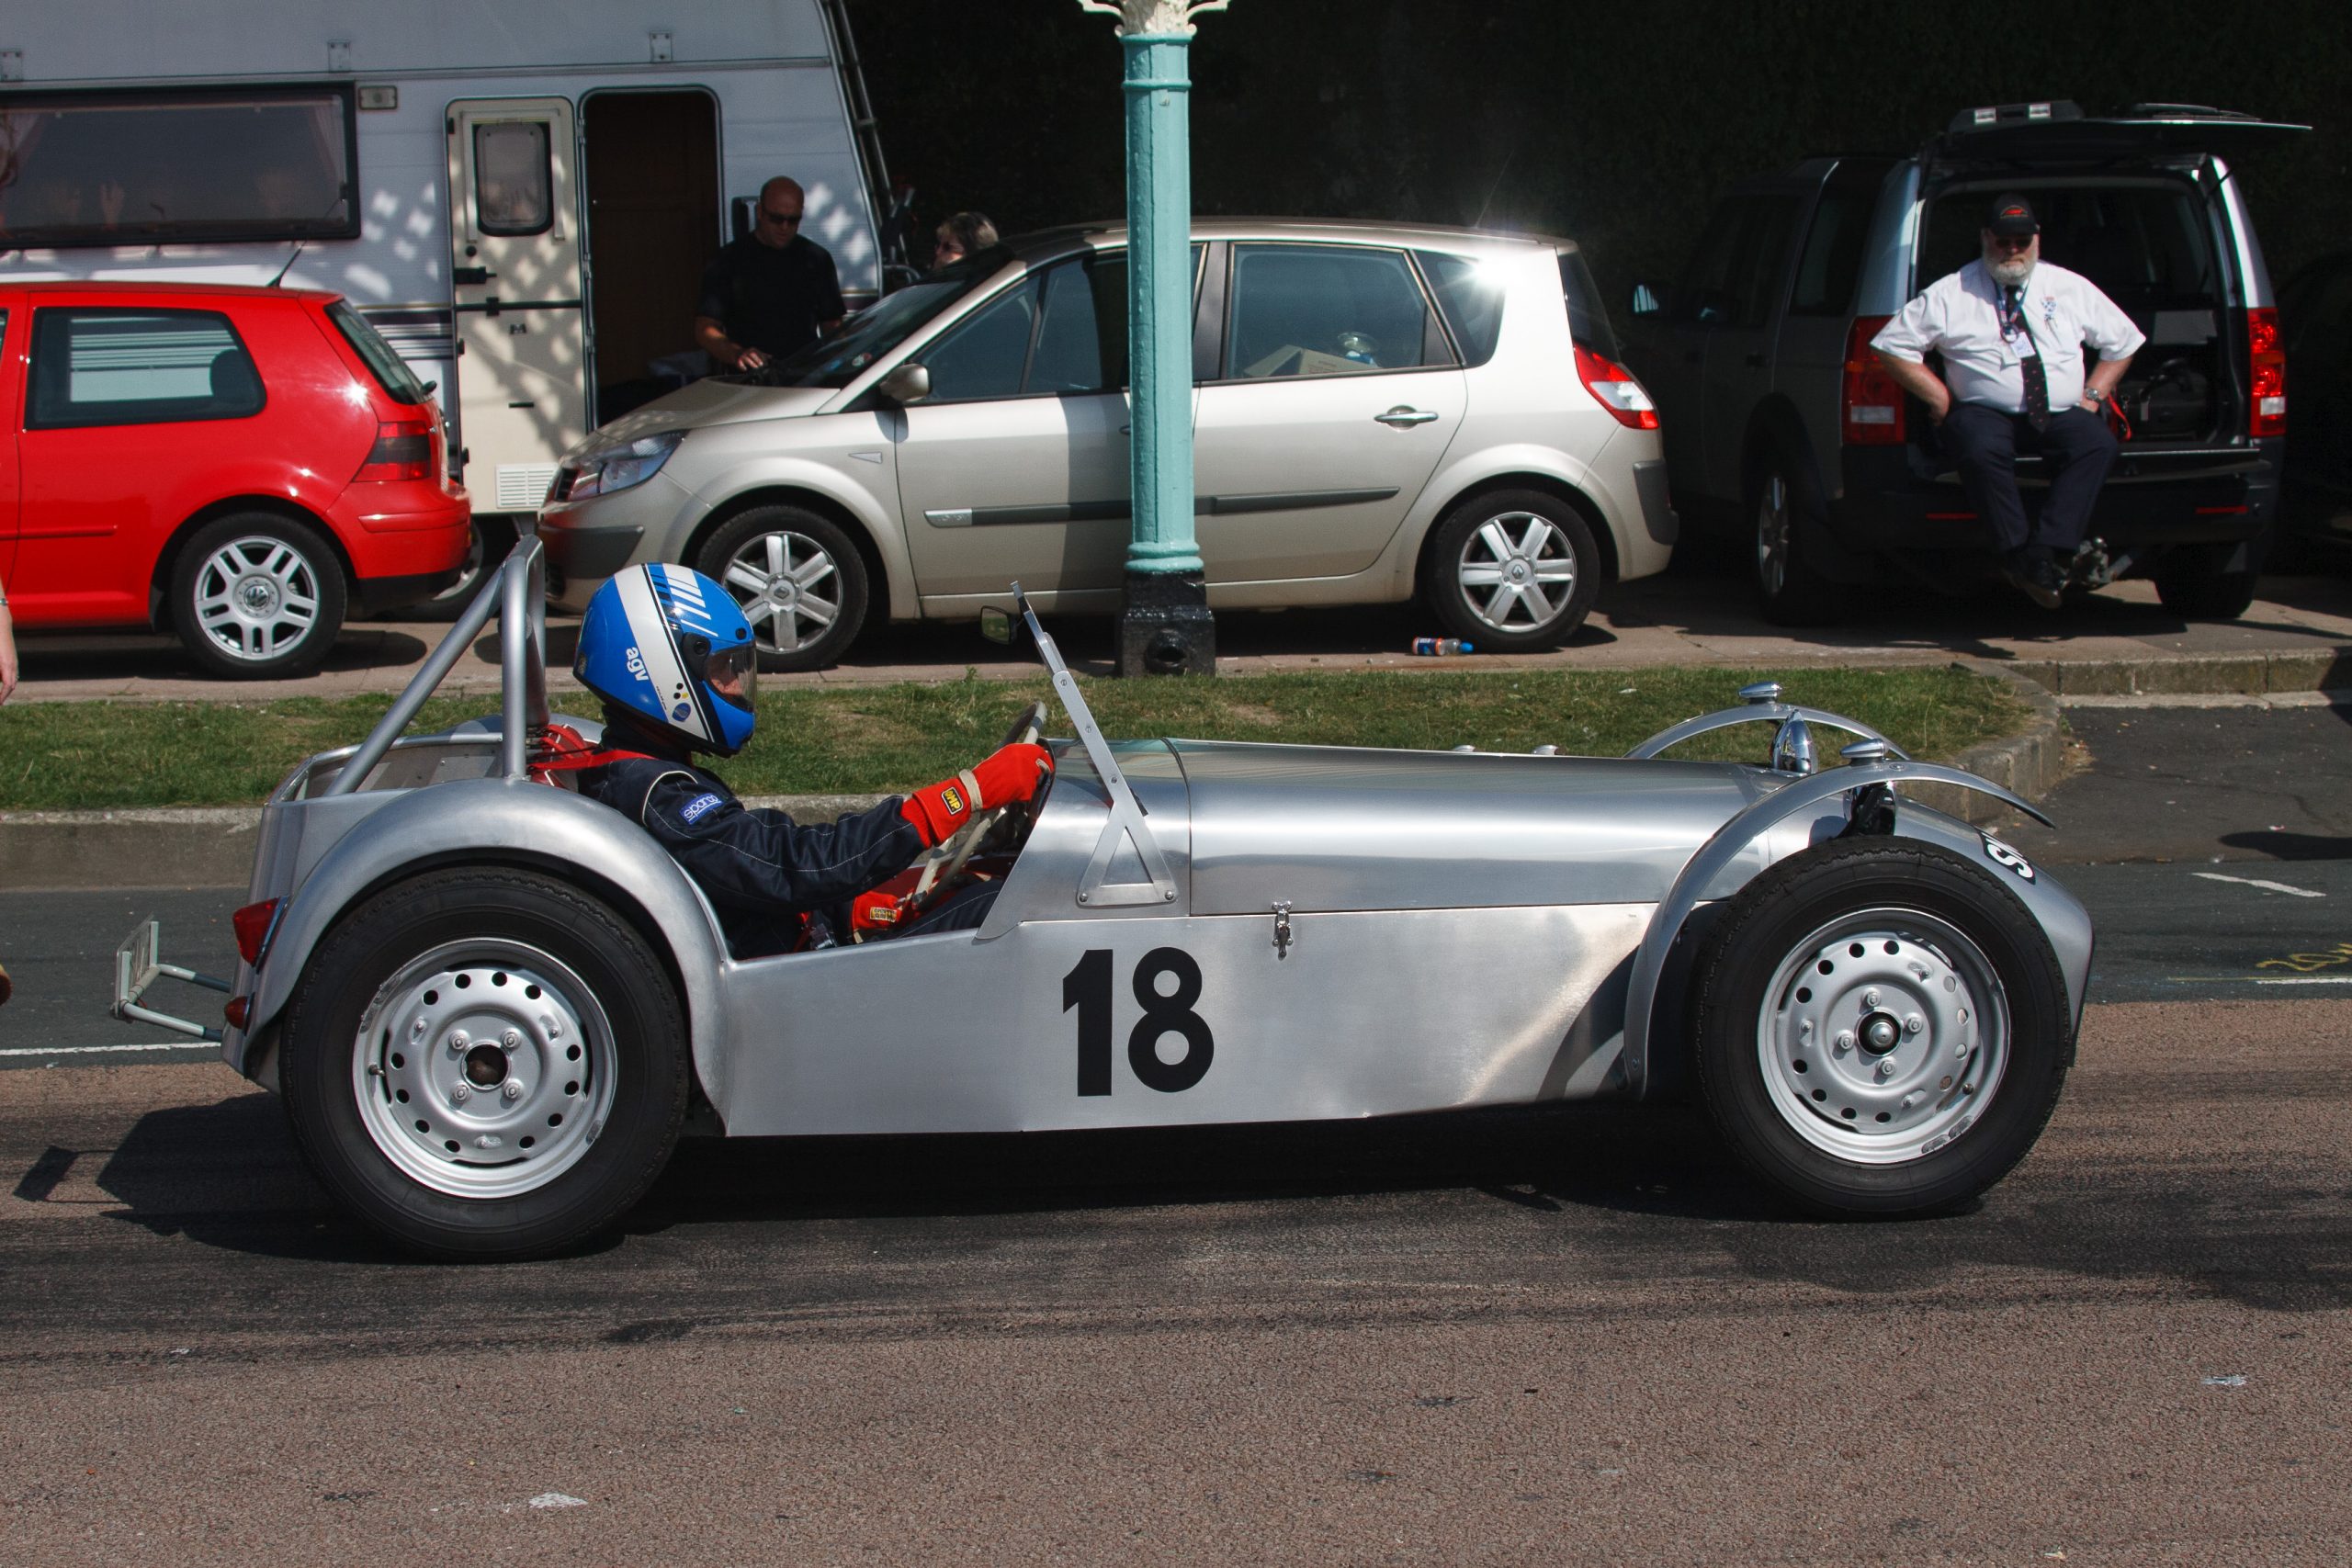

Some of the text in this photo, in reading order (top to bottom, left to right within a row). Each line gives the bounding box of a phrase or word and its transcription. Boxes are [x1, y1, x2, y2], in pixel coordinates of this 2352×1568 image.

[626, 647, 649, 682] agv
[684, 795, 719, 819] sparco
[1062, 946, 1215, 1097] 18
